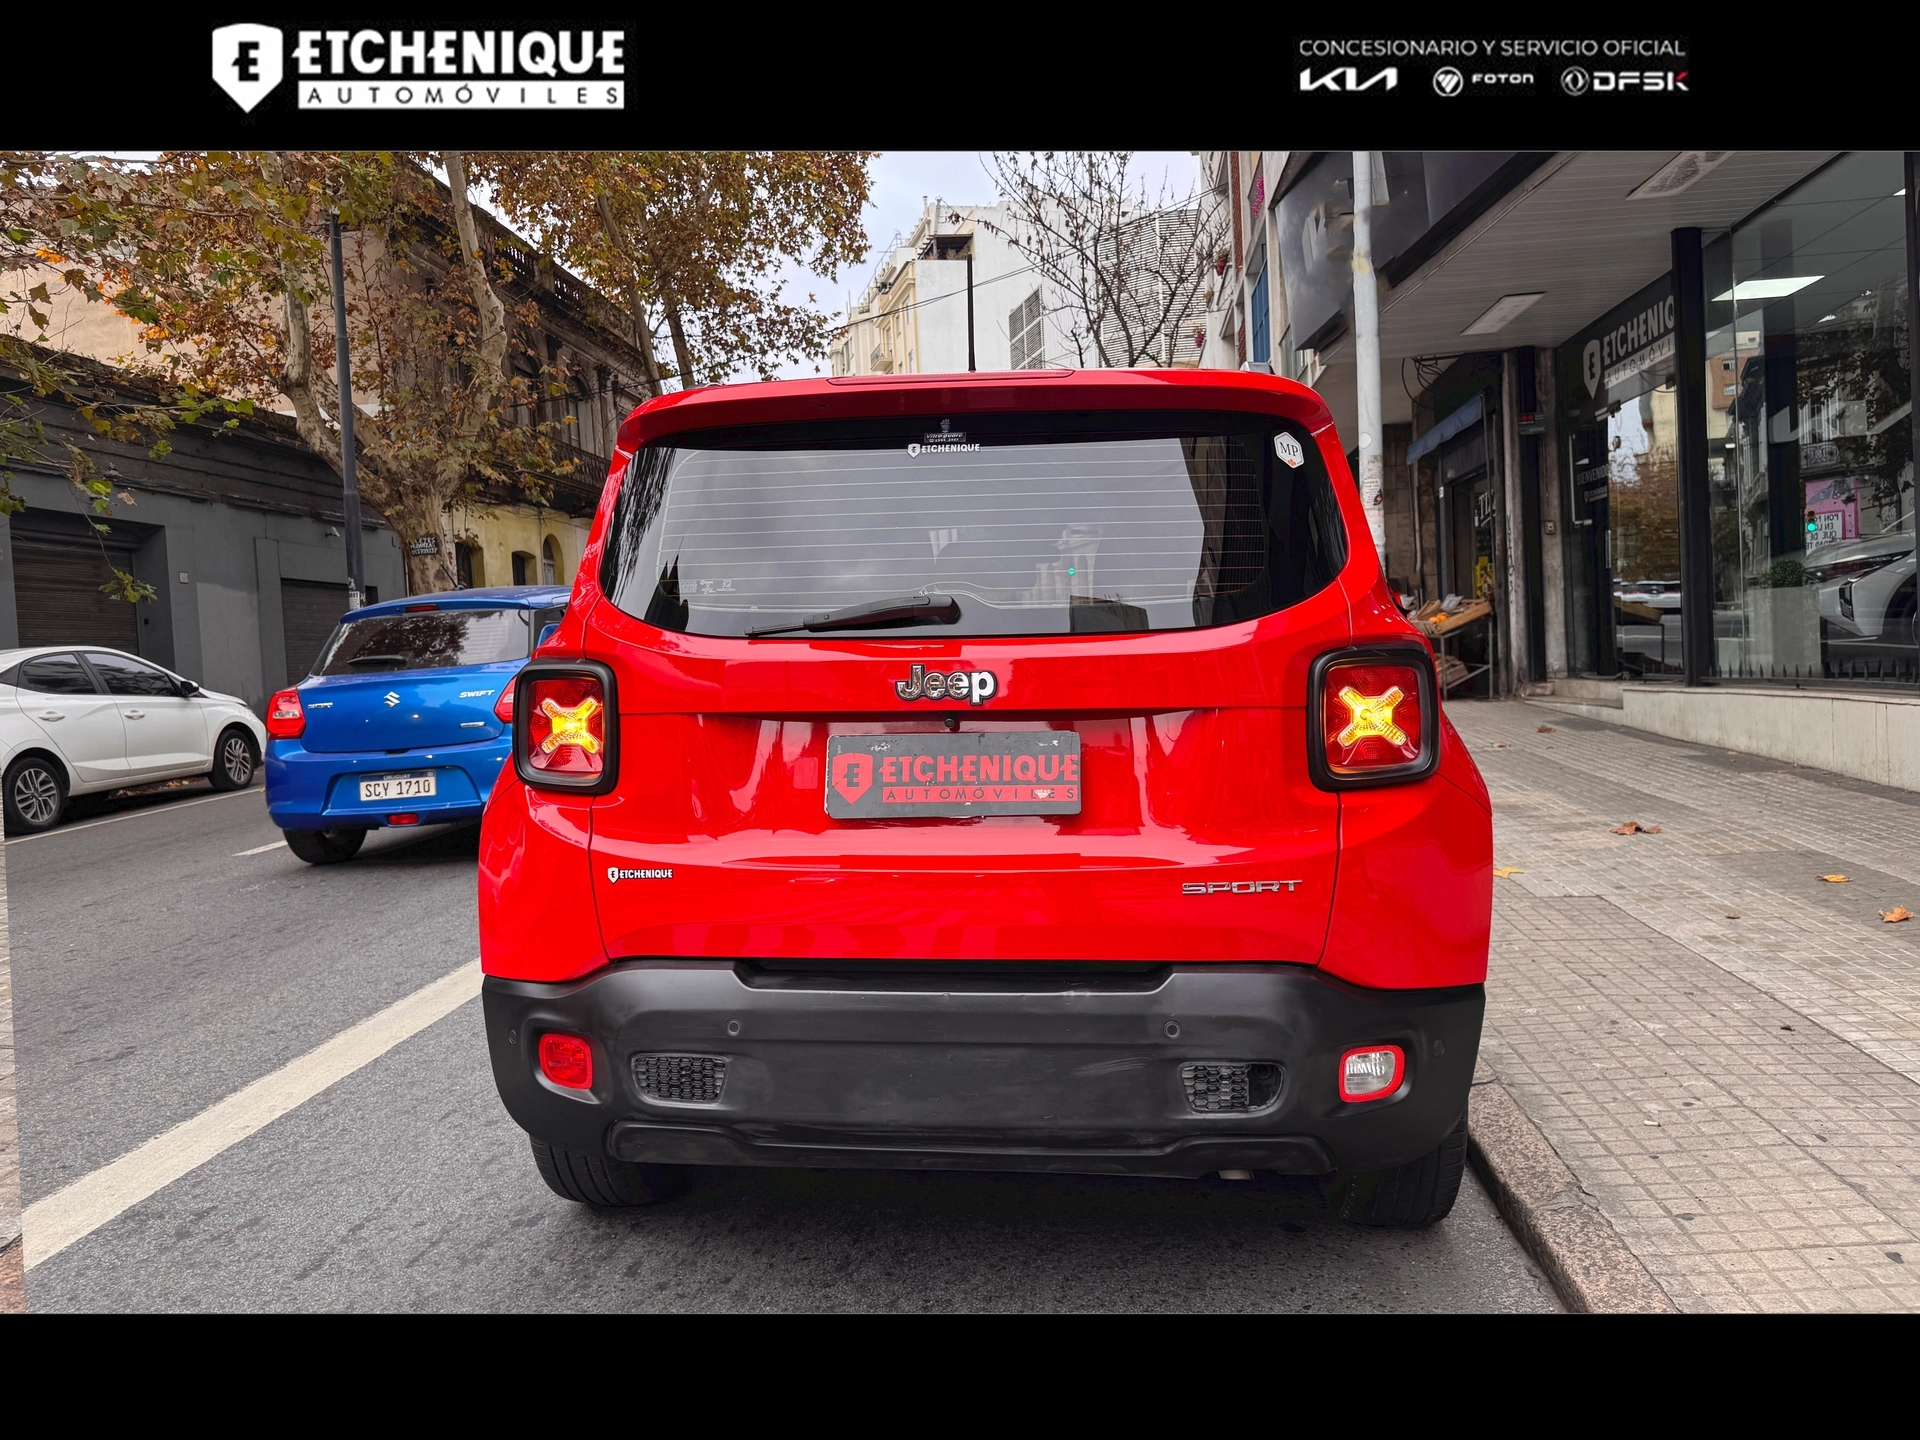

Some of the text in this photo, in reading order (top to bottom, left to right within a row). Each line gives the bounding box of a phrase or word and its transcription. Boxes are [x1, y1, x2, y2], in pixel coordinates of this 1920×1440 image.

[1602, 294, 1675, 367] ETCHENIQ
[1606, 337, 1672, 385] AUTOMÓVI
[920, 443, 981, 453] ETCHENIQUE
[1279, 441, 1299, 457] MP
[896, 664, 997, 704] Jeep
[459, 689, 496, 698] SWIFT
[879, 754, 1079, 783] ETCHENIQUE
[383, 773, 411, 781] URUGUAY
[365, 779, 431, 798] SCY 1710
[886, 786, 1075, 800] AUTOMÓVILES
[619, 869, 673, 879] ETCHENIQUE
[1181, 879, 1303, 895] SPORT
